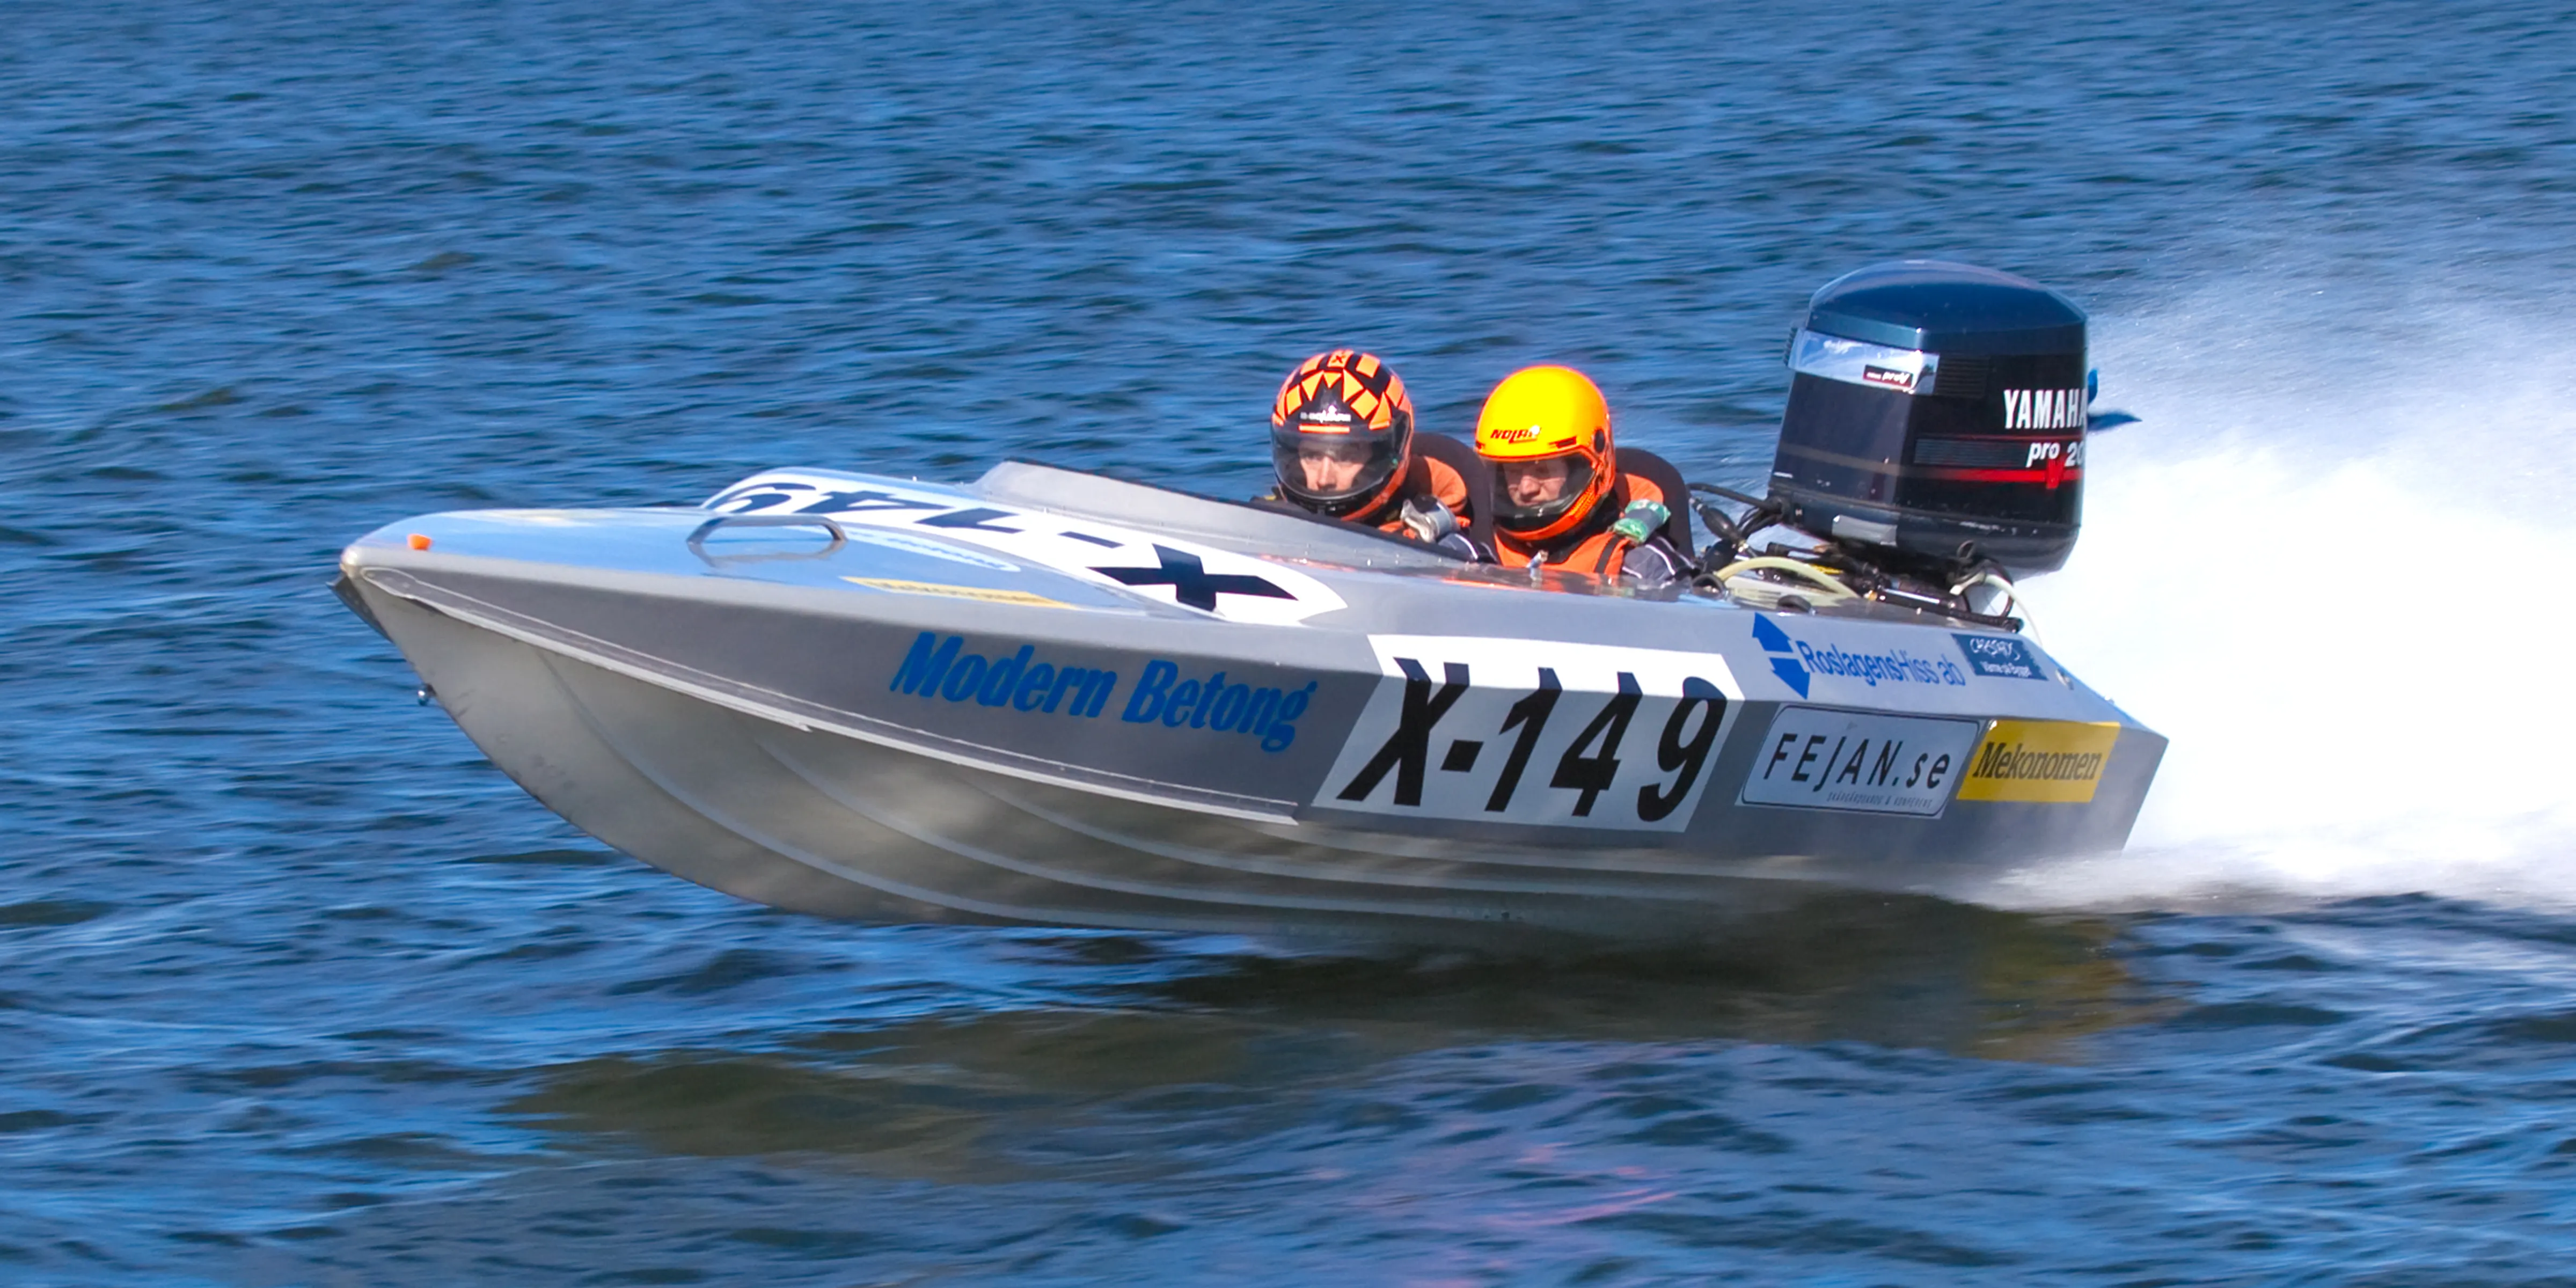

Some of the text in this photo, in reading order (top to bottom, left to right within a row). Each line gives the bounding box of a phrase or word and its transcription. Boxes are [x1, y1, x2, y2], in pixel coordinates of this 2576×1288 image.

[889, 631, 1318, 752] Modern Betong
[1937, 653, 1966, 686] ab
[1336, 656, 1728, 822] X-149
[1763, 733, 1950, 792] FEJAN.se
[1972, 741, 2103, 780] Mekonomen
